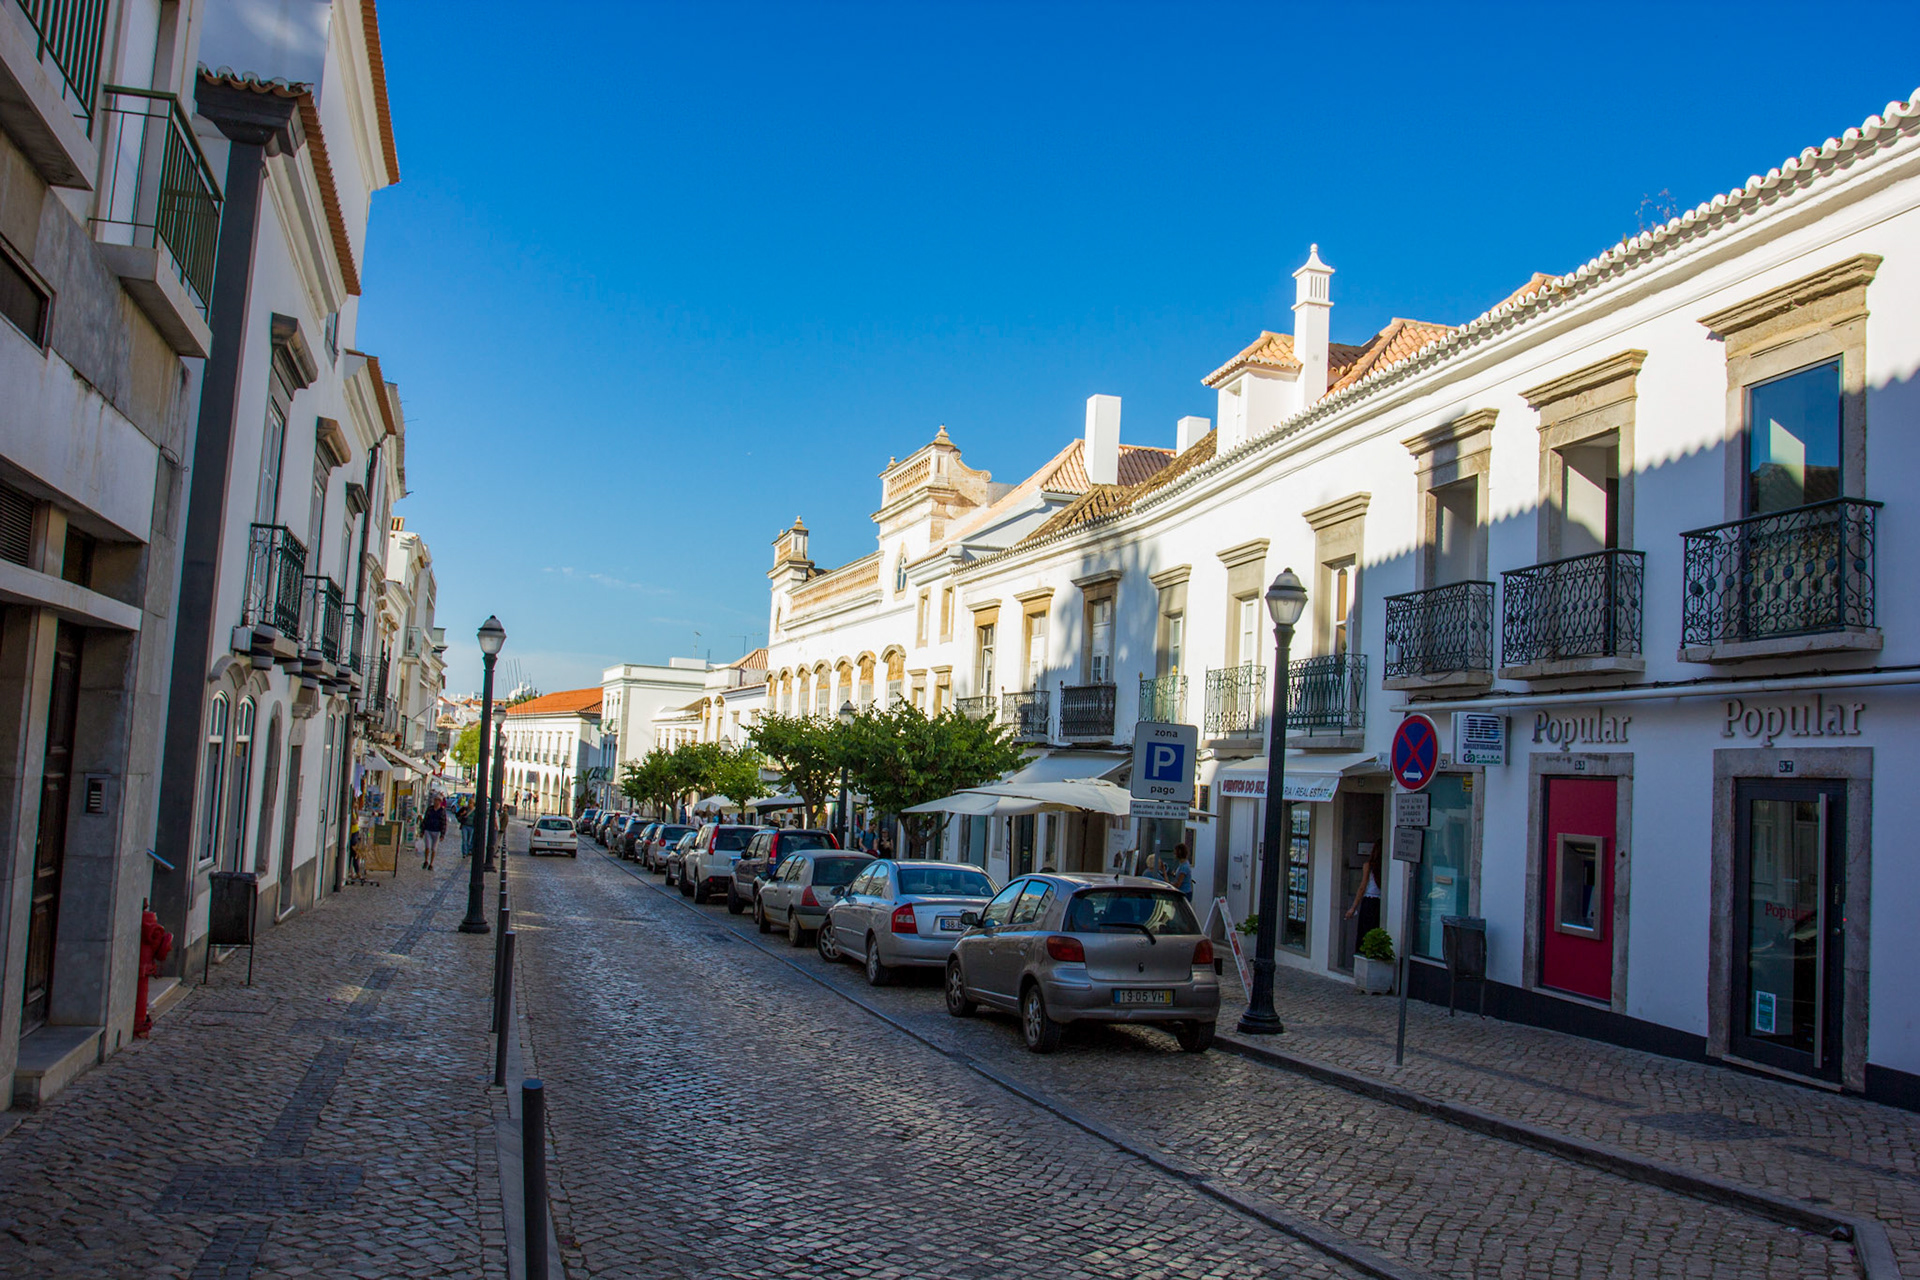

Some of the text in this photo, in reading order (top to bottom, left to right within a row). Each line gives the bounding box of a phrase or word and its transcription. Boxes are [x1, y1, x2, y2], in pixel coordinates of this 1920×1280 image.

[1720, 694, 1865, 747] Popular
[1155, 730, 1178, 738] zona
[1532, 709, 1631, 751] Popular
[1152, 746, 1176, 777] P
[1780, 761, 1792, 771] 57
[1150, 786, 1175, 796] pago
[1245, 780, 1255, 793] DO
[1295, 787, 1309, 797] REAL
[1309, 788, 1329, 798] ESTATE
